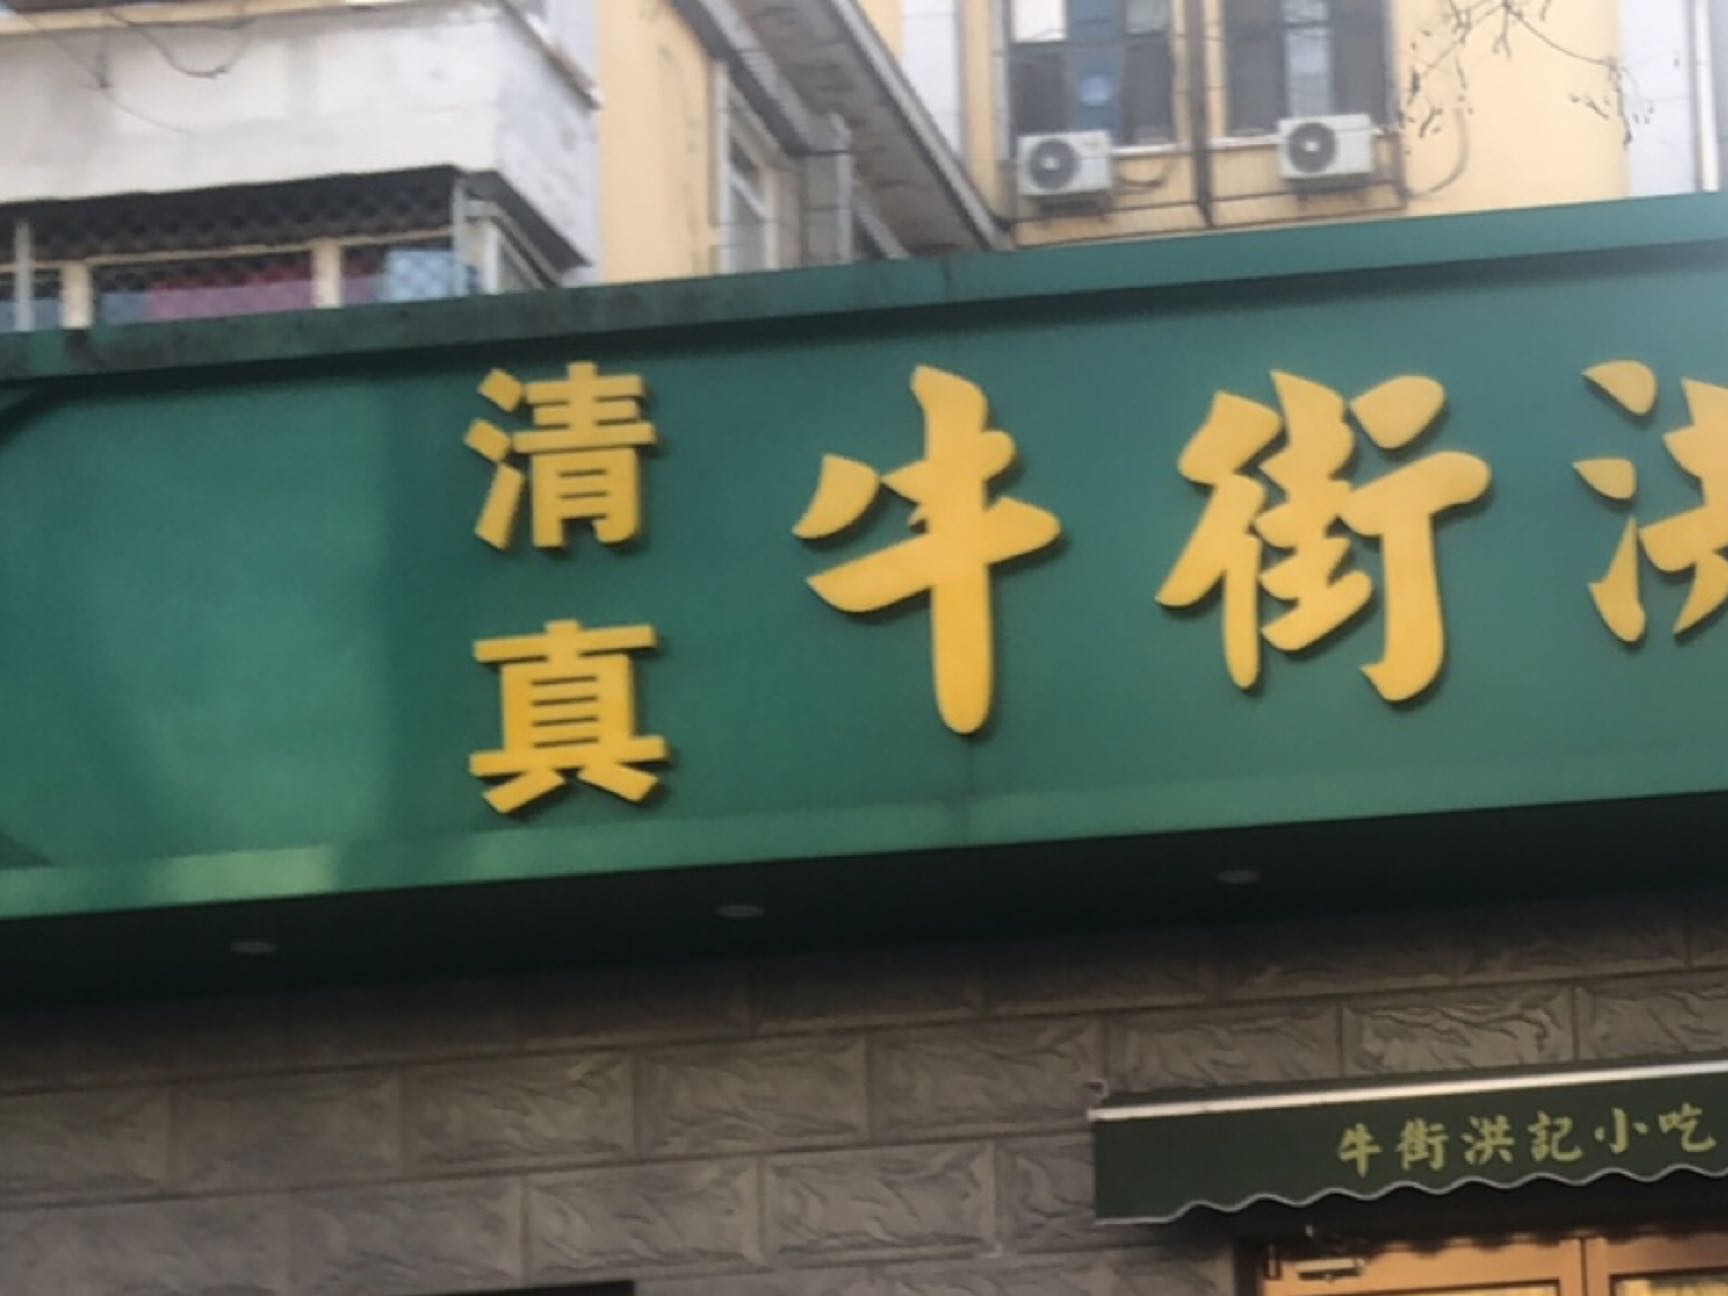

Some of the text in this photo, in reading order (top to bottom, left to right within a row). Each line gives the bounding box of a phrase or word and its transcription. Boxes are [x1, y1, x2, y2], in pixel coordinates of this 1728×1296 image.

[463, 361, 670, 814] 清真
[1338, 1103, 1717, 1178] 牛街洪記小吃
